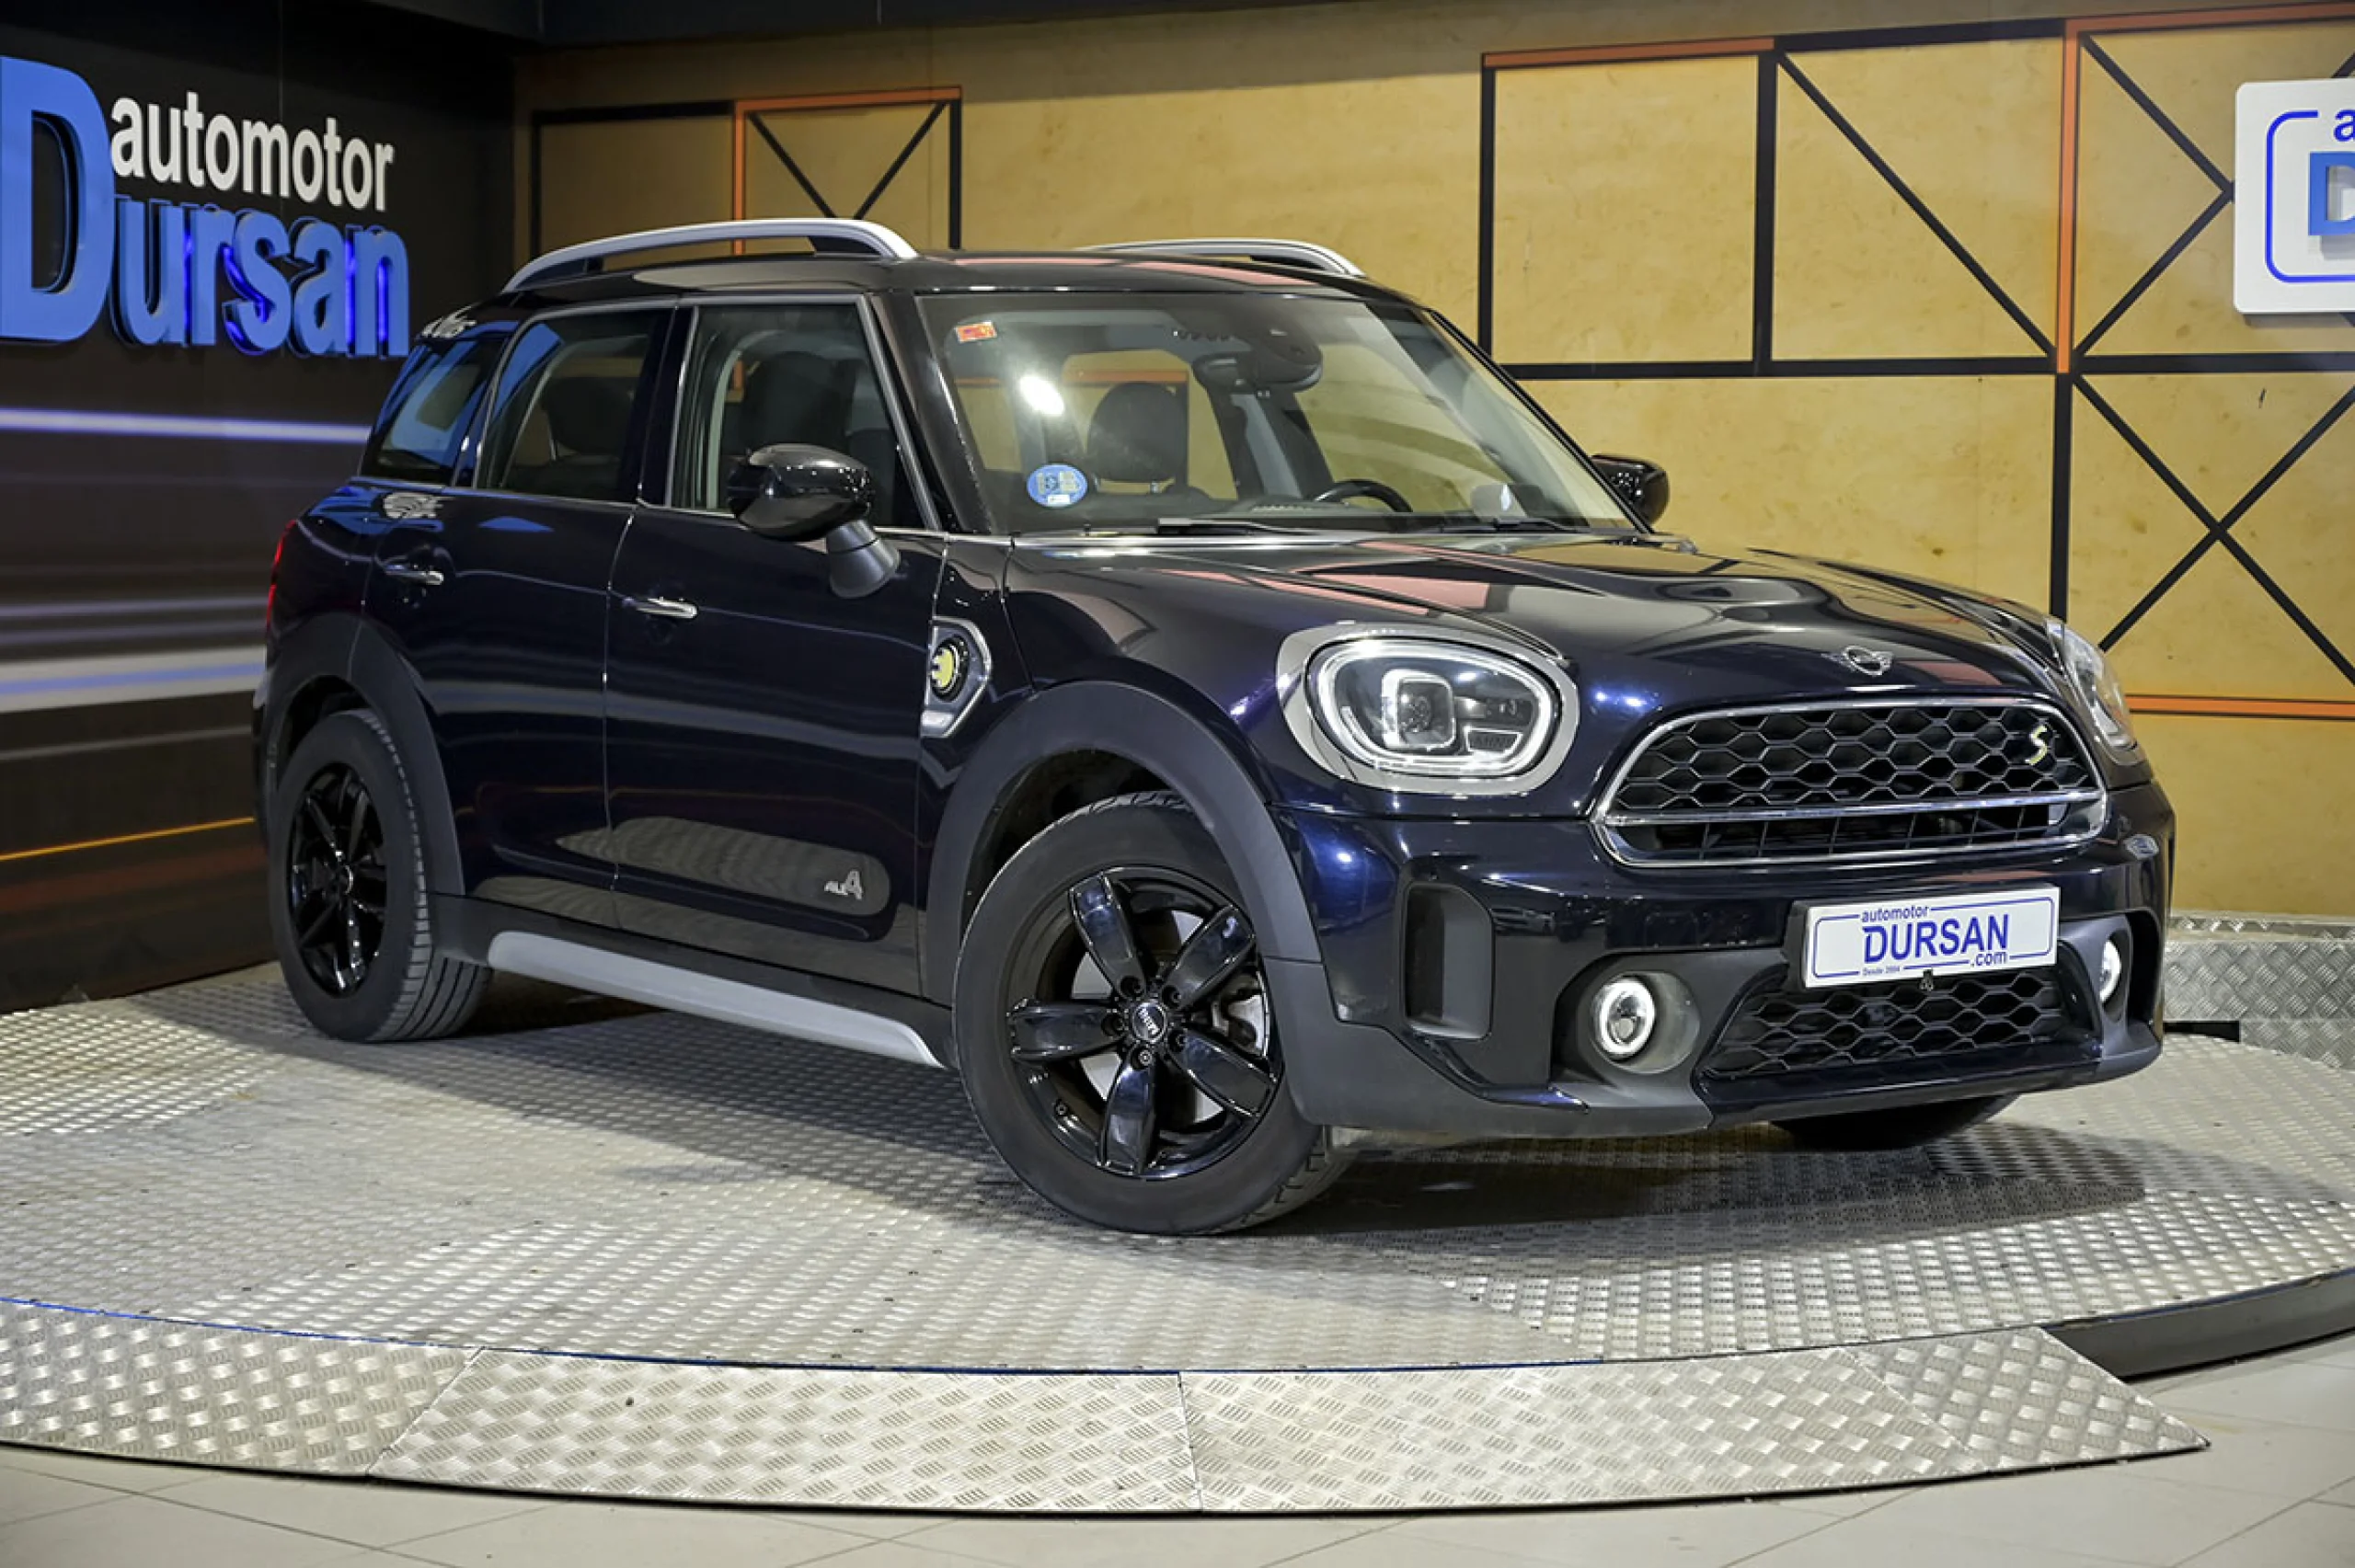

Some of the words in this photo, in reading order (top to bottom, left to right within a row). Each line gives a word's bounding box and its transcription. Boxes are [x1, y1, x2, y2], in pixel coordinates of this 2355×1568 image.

[110, 90, 395, 212] automotor
[0, 55, 409, 358] Dursan
[1861, 905, 1930, 922] automotor
[1861, 913, 2009, 963] DURSAN
[1970, 950, 2008, 967] .com
